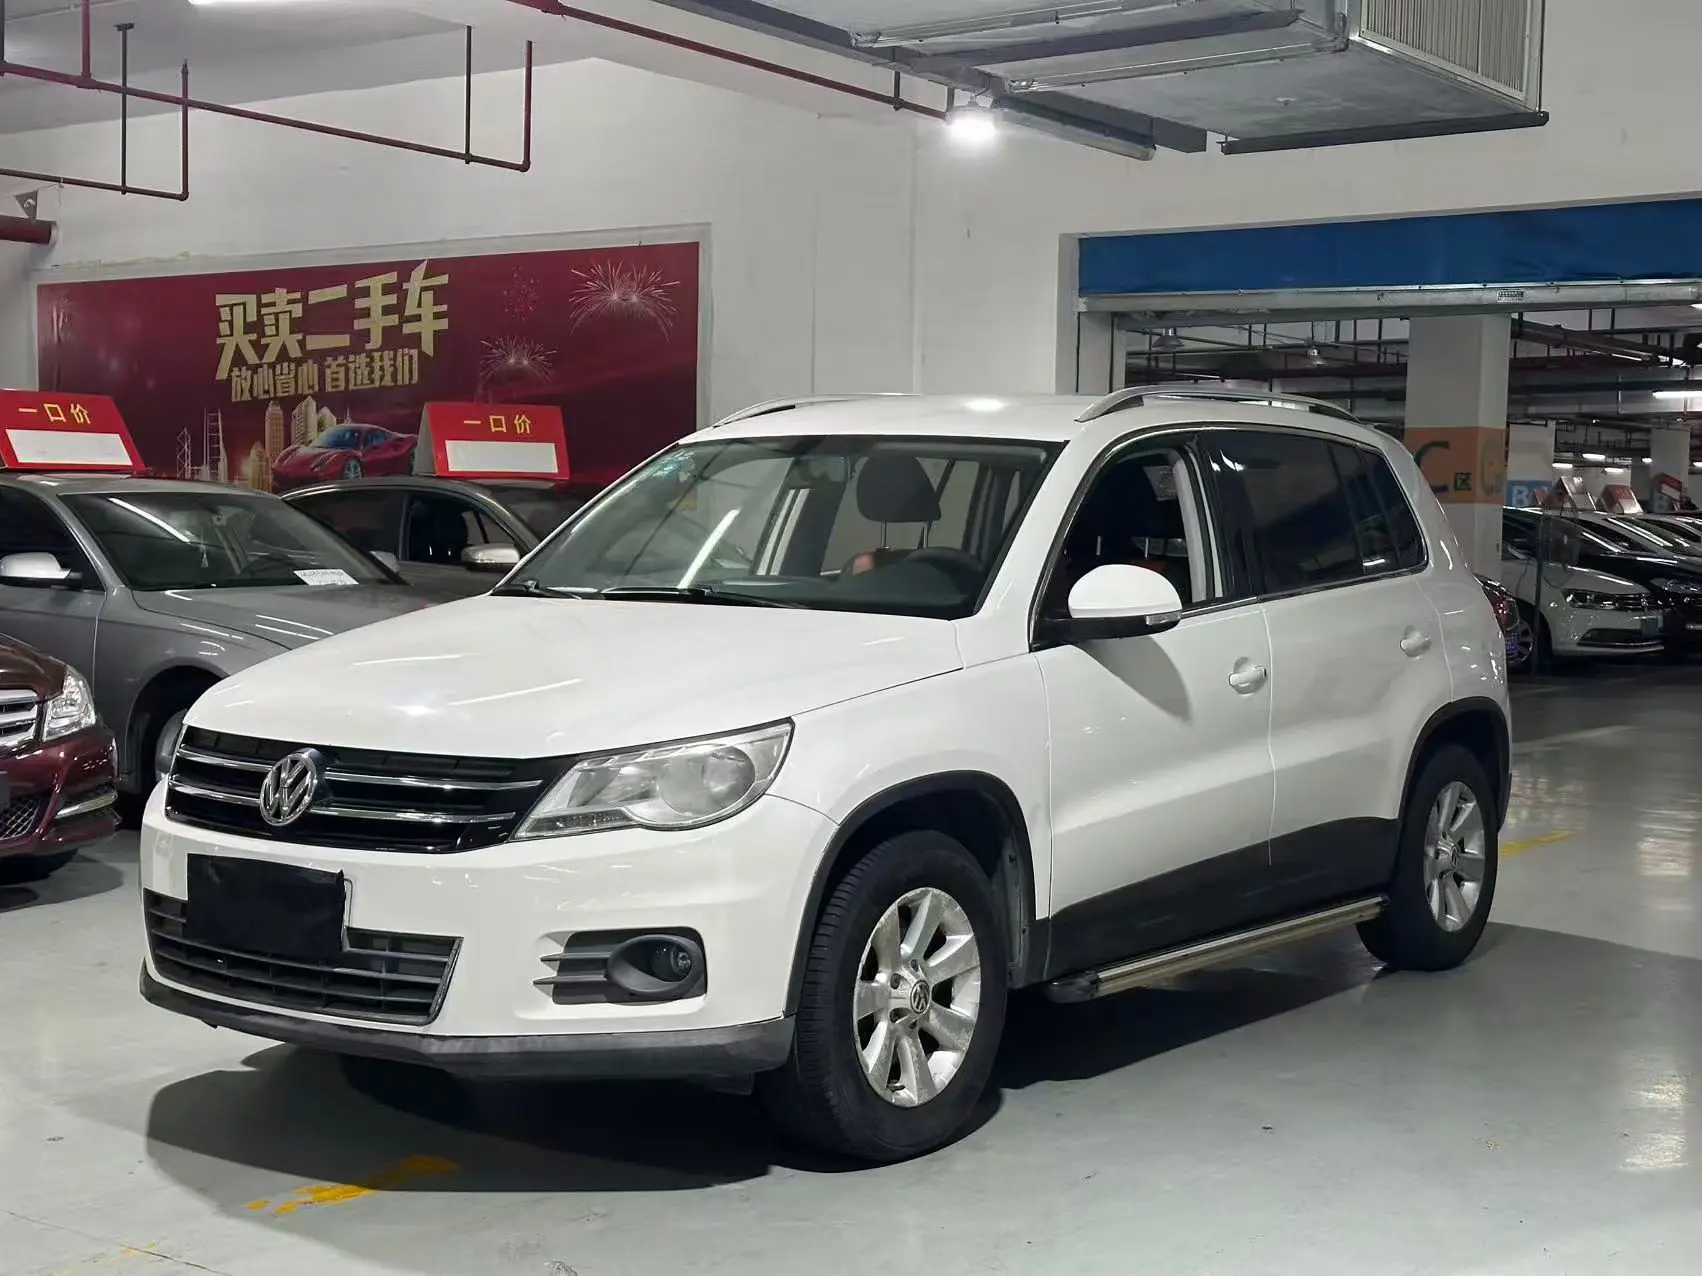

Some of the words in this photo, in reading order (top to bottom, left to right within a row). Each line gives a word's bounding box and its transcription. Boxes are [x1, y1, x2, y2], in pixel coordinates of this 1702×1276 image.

[215, 259, 449, 380] 买卖二手车
[231, 359, 319, 402] 放心省心
[325, 347, 419, 392] 首选我们
[18, 402, 91, 424] 一口价
[463, 414, 531, 434] 一口价
